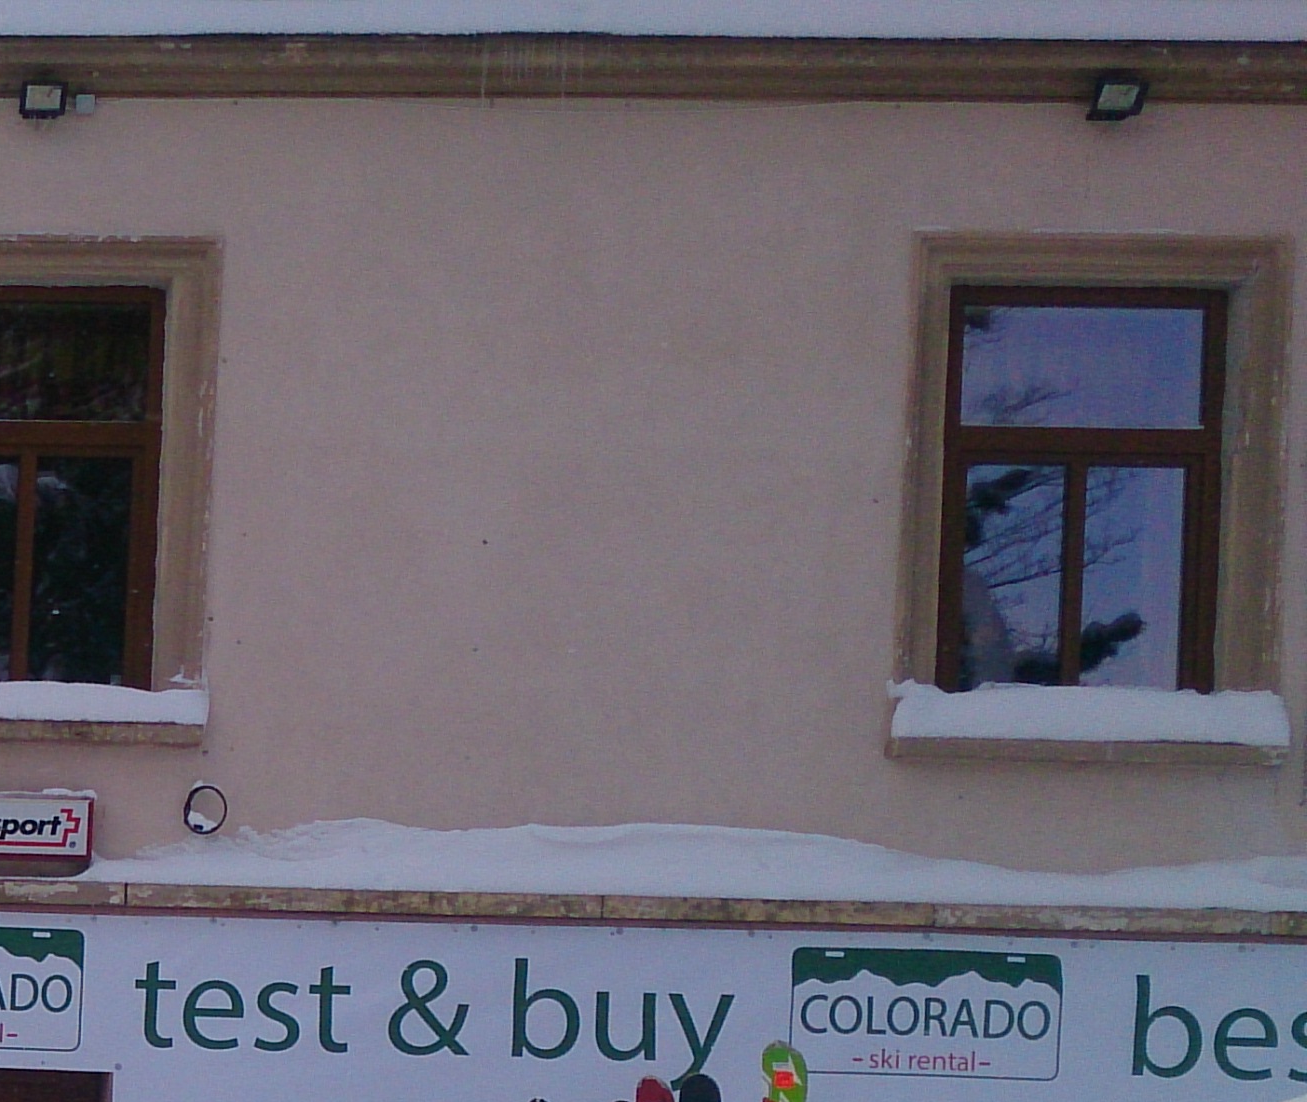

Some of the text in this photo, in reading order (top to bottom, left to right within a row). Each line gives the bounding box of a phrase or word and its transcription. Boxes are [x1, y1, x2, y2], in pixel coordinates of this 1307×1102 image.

[134, 957, 736, 1091] test & buy
[800, 993, 1052, 1041] COLORADO
